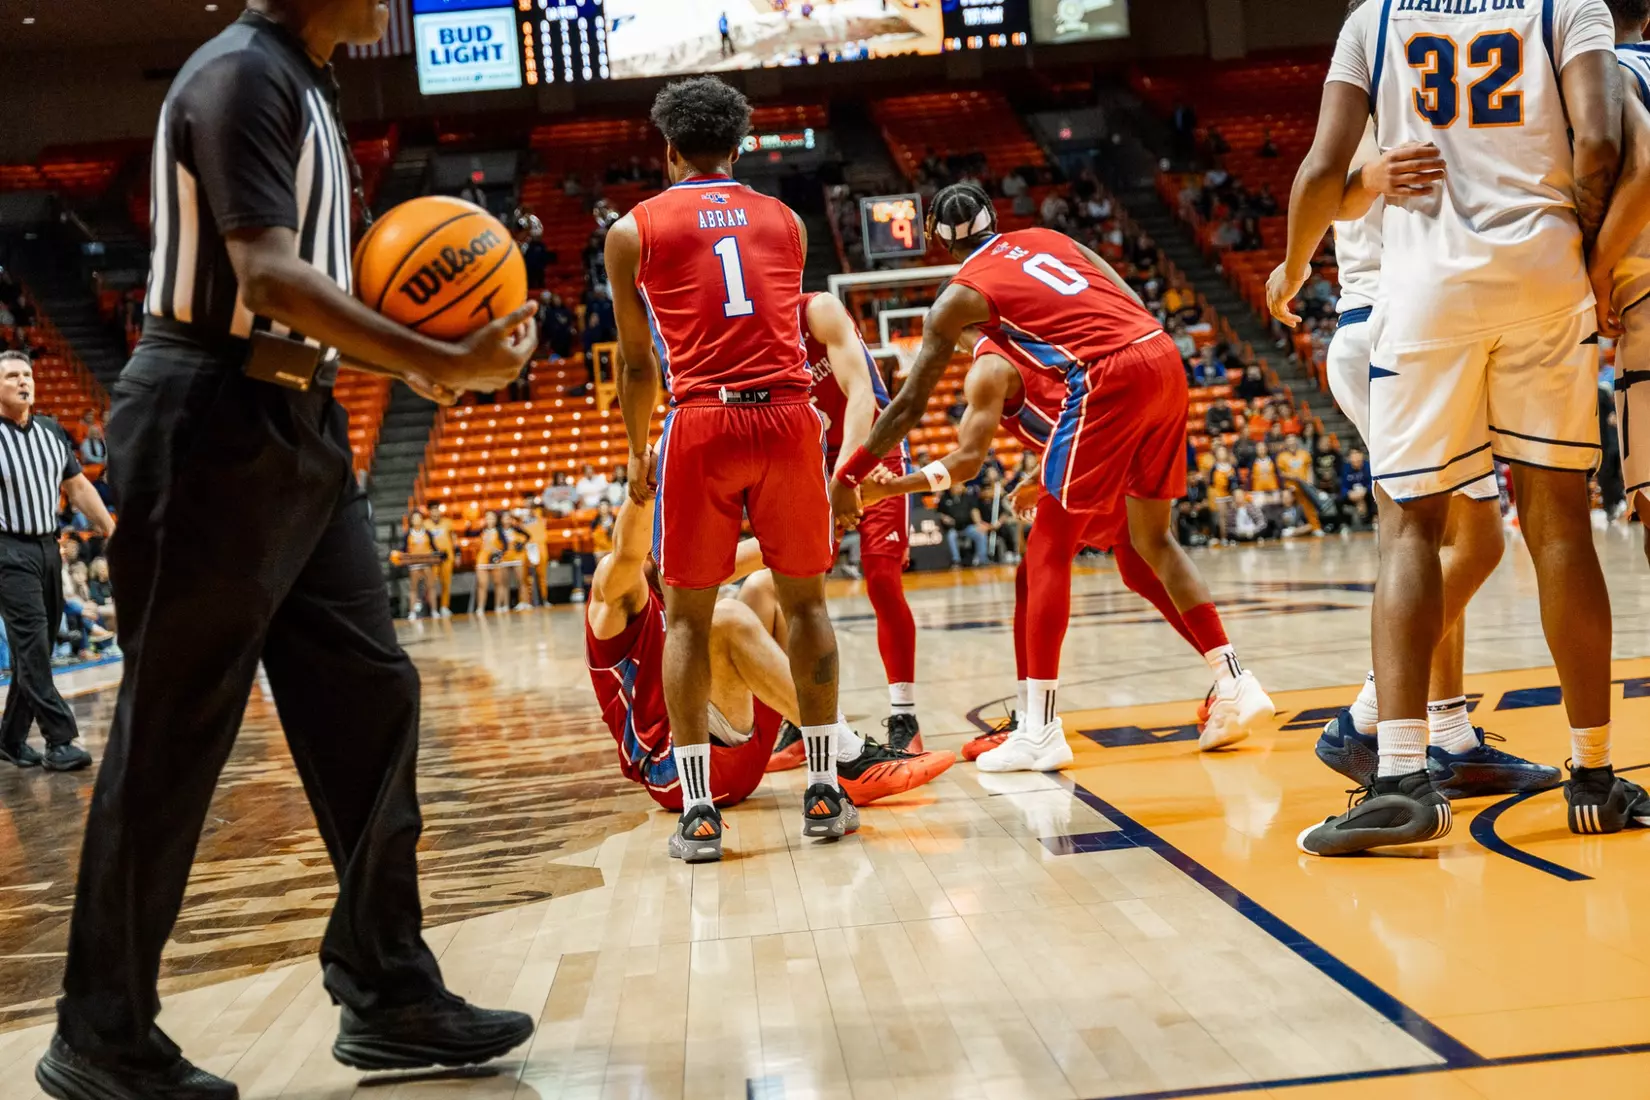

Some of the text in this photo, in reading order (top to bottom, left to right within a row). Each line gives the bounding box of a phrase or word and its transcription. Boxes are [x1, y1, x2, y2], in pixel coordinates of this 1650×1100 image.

[439, 25, 493, 45] BUD
[430, 43, 504, 66] LIGHT
[1404, 28, 1525, 129] 32
[698, 208, 748, 229] ABRAM
[892, 219, 913, 248] 9
[398, 229, 502, 305] Wilson
[712, 235, 755, 318] 1
[1022, 253, 1090, 296] 0
[810, 357, 833, 387] ECH
